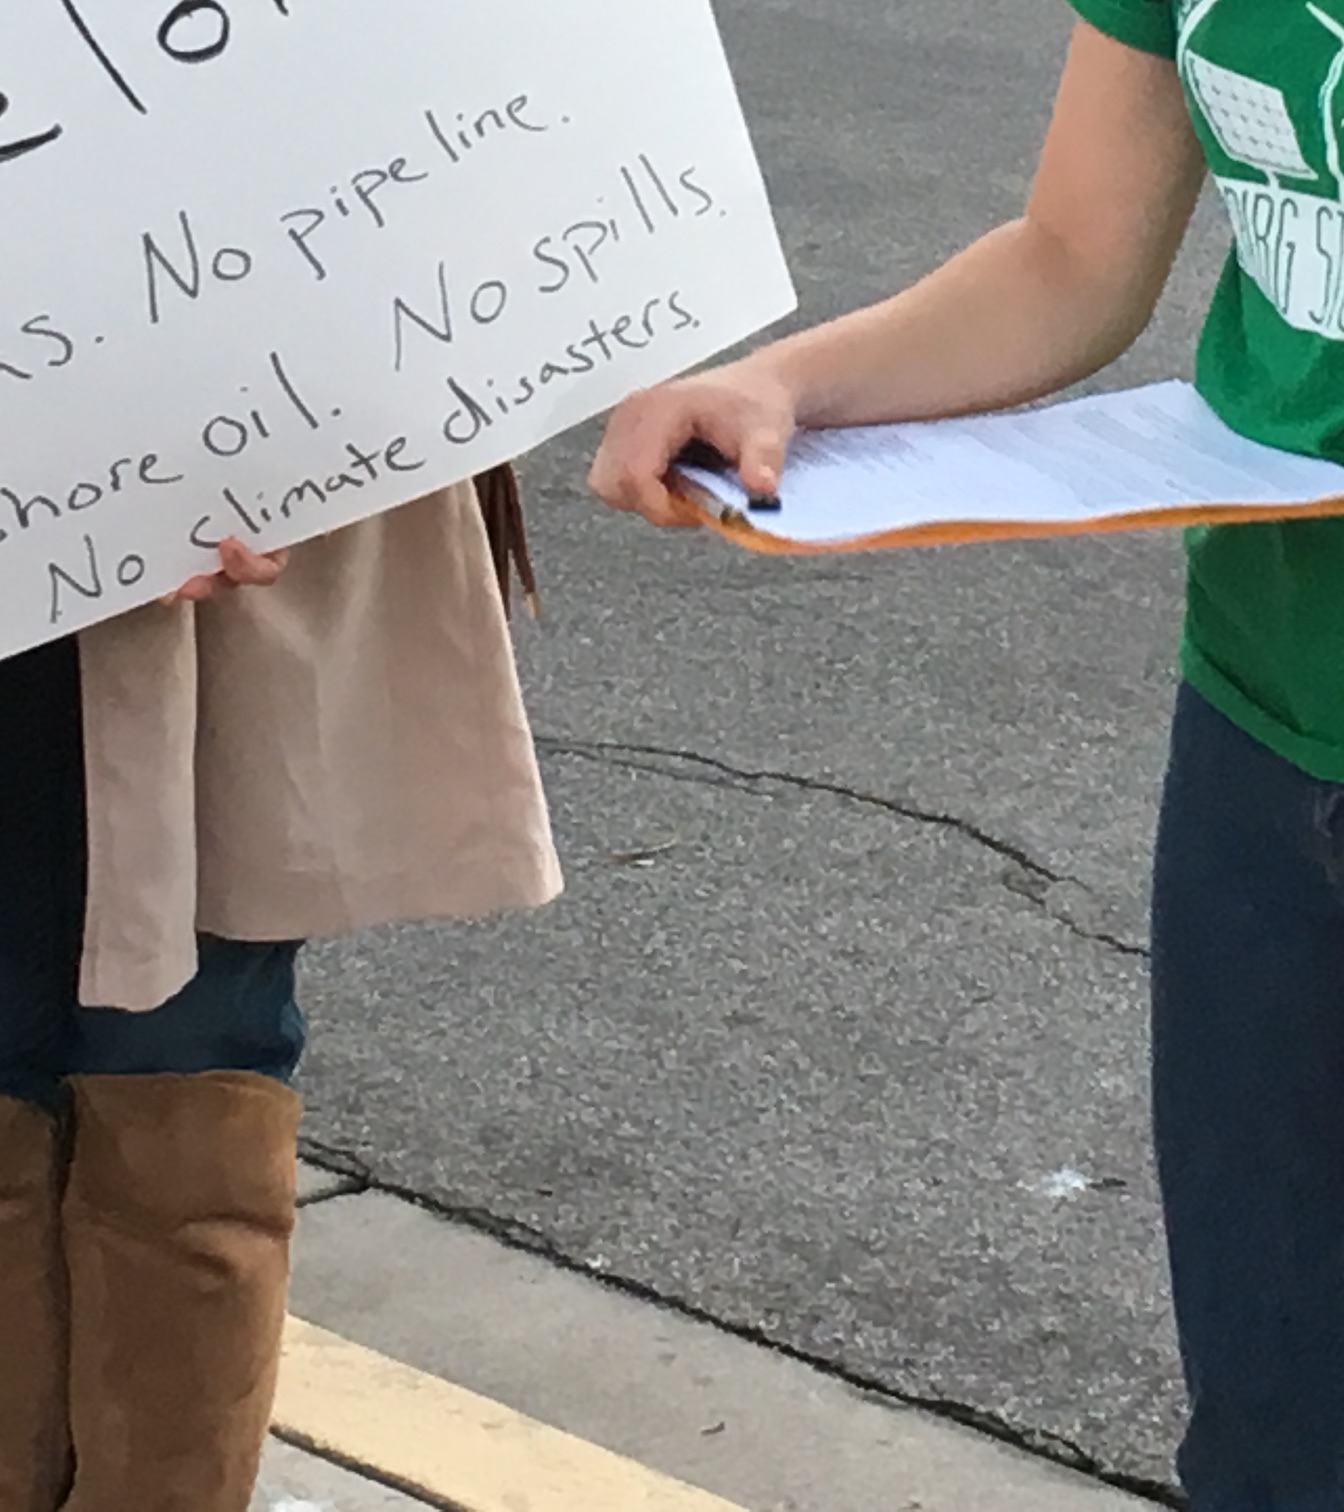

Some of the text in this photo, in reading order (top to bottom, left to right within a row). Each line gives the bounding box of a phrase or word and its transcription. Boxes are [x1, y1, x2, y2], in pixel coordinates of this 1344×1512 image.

[141, 208, 253, 326] No
[279, 94, 571, 281] pipeline.
[201, 351, 343, 457] oil.
[392, 260, 508, 373] No
[532, 153, 728, 294] spills.
[47, 290, 701, 624] No climate disasters.
